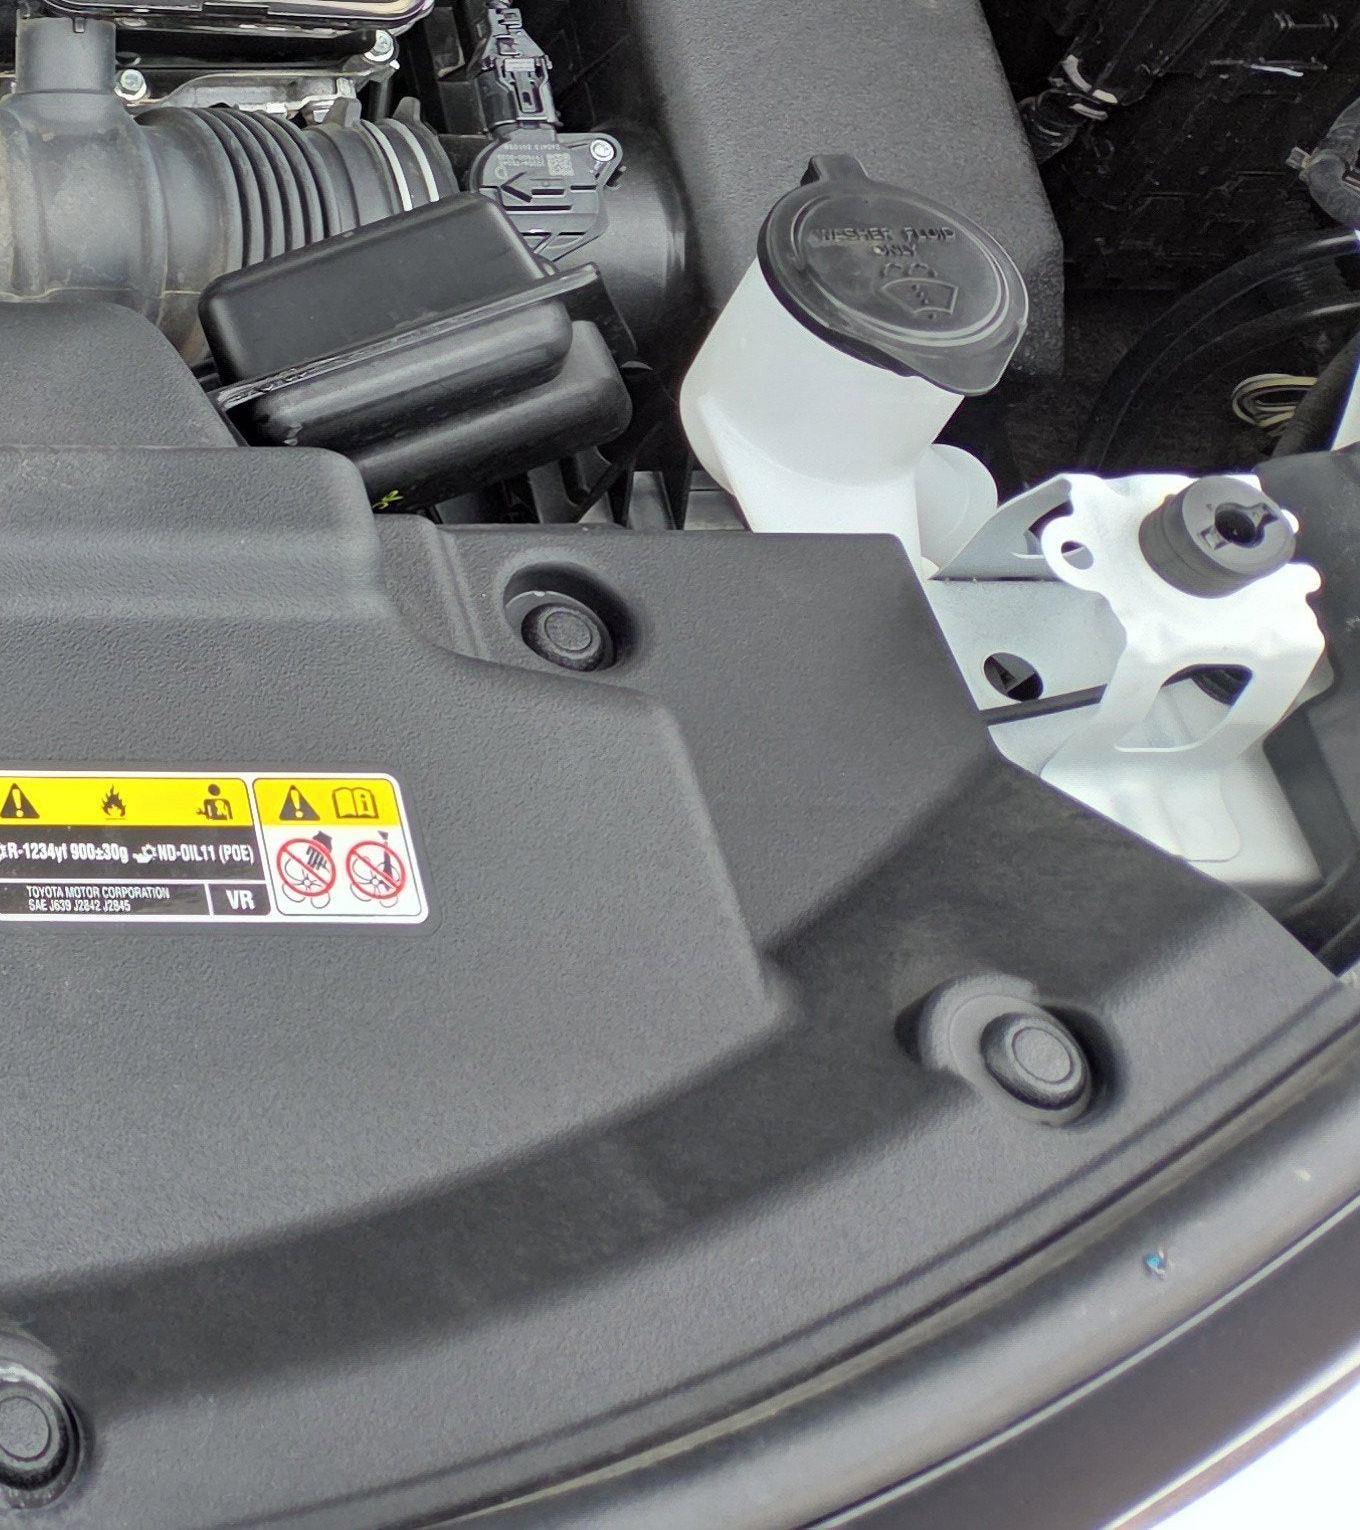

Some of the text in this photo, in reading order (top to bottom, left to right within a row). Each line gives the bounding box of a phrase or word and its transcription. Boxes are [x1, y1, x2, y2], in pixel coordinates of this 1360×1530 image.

[810, 226, 956, 243] WASHER FLUID
[872, 243, 918, 258] ONLY
[7, 843, 255, 864] R-1234yf 900±30g ND-OIL11 (POE)
[26, 885, 171, 900] TOYOTA MOTOR CORPORATION
[225, 889, 256, 910] VR
[28, 899, 131, 913] SAE J639 J2842 J2845
